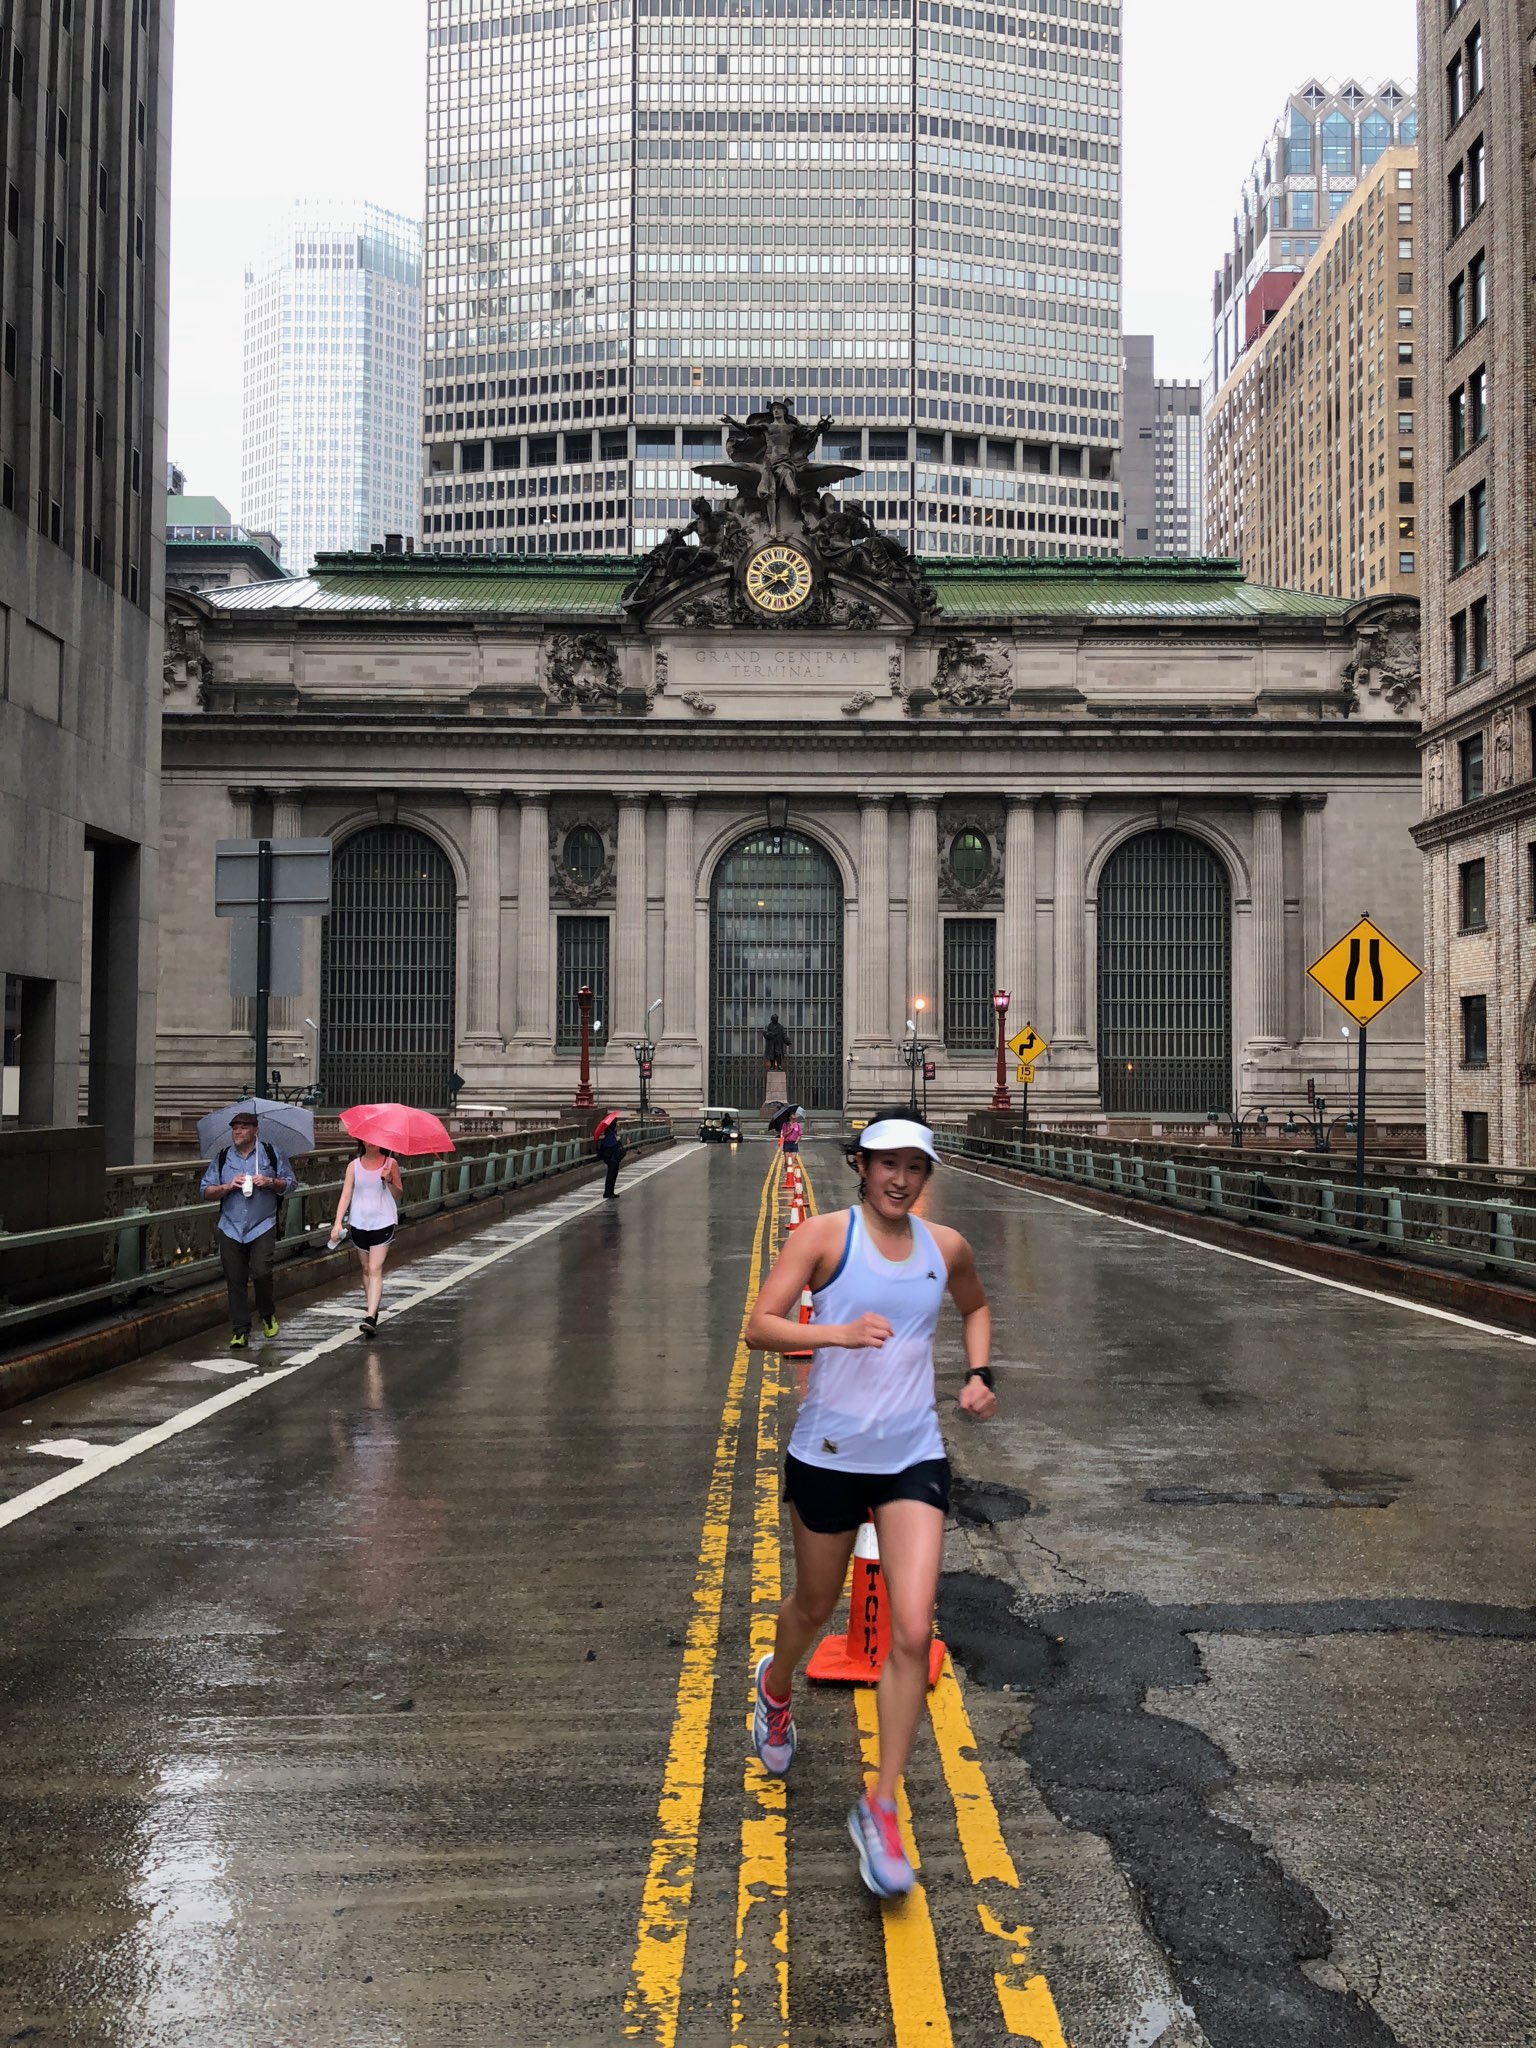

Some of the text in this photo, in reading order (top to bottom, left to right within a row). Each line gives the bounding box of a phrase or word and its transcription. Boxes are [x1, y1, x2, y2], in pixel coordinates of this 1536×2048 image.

[695, 651, 862, 664] GRAND CENTRAL
[731, 665, 825, 678] TERMINAL
[1021, 1066, 1031, 1076] 15
